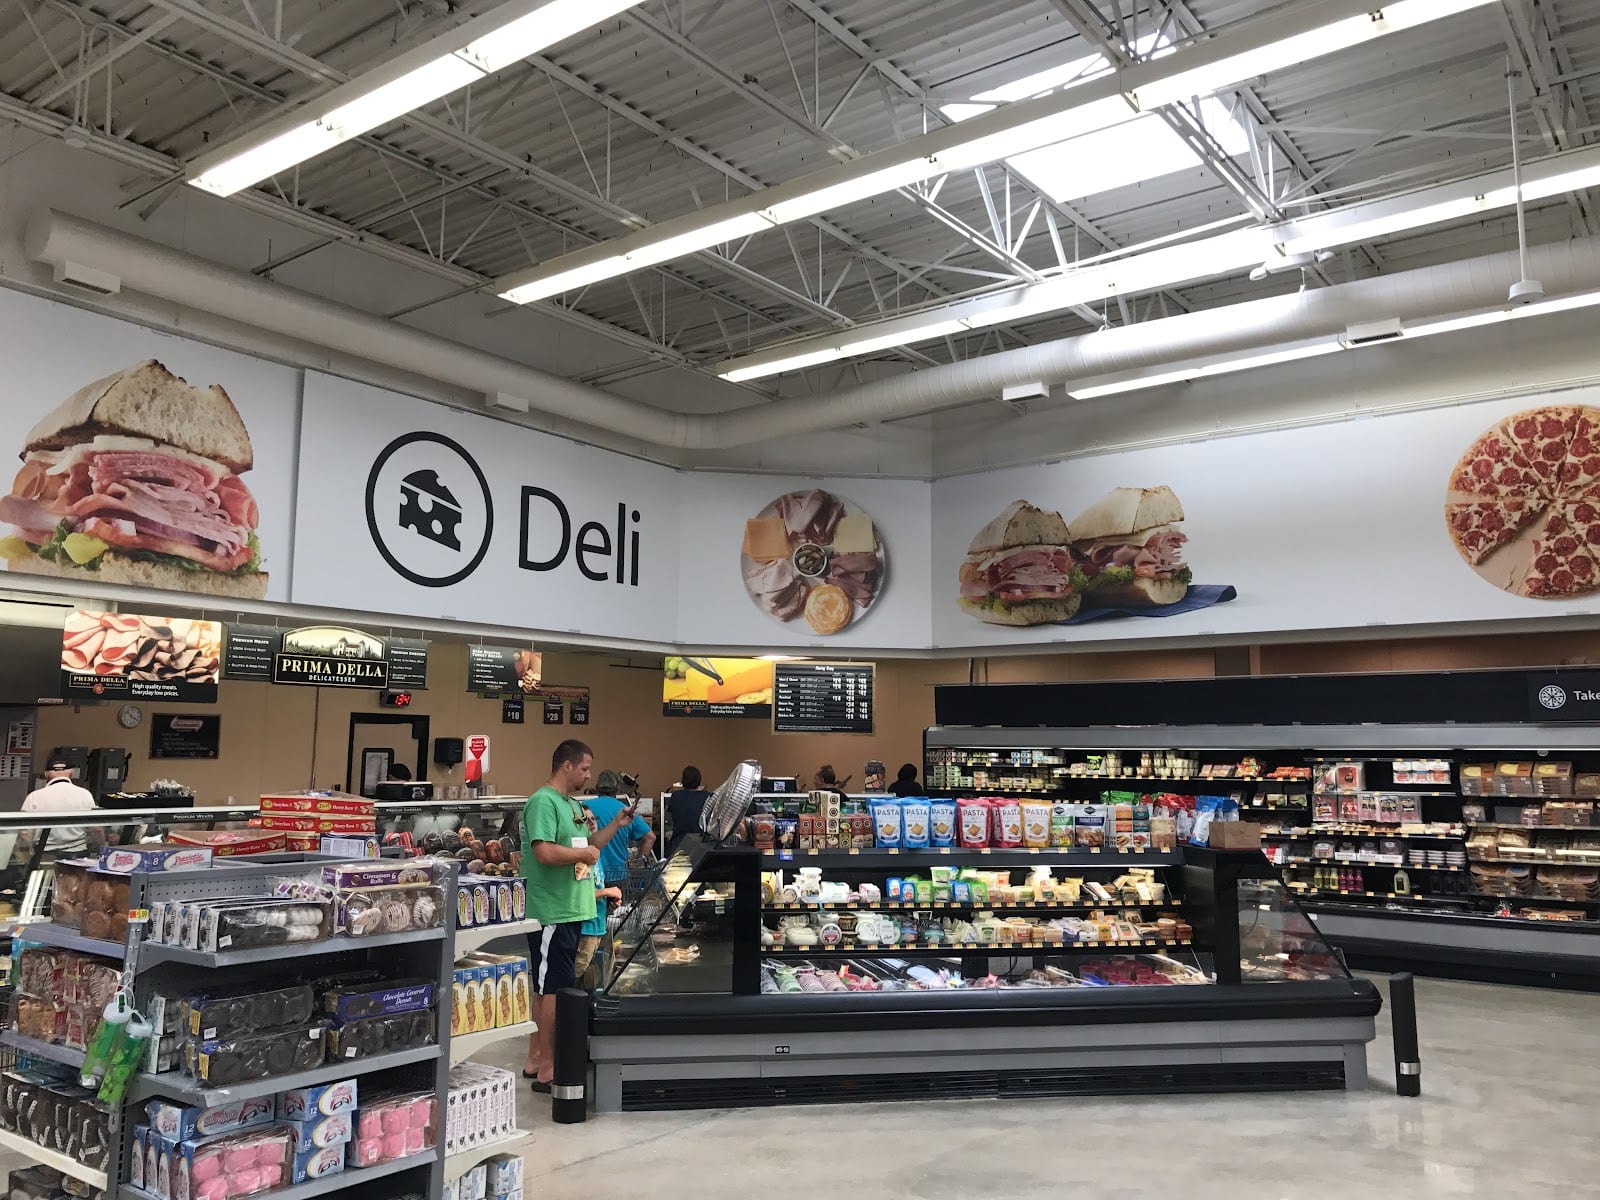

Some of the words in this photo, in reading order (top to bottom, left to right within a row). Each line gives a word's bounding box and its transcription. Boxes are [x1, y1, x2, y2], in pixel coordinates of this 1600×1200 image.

[519, 485, 640, 586] Deli
[282, 659, 331, 675] PRIMA
[337, 662, 384, 678] DELLA
[309, 674, 356, 683] DELICATESSEN
[132, 682, 144, 690] High
[1573, 690, 1600, 701] Take
[507, 711, 520, 720] $18
[547, 712, 559, 721] $28
[575, 713, 585, 722] $38
[906, 808, 927, 816] PASTA
[153, 857, 159, 866] 8
[363, 872, 390, 880] Cinnamon
[391, 872, 397, 880] 6
[383, 991, 405, 1001] Chocolate
[406, 986, 426, 996] Covered
[423, 996, 429, 1005] 8
[311, 1107, 318, 1115] 12
[184, 1123, 195, 1134] 12
[304, 1139, 312, 1147] 12
[298, 1170, 306, 1179] 12
